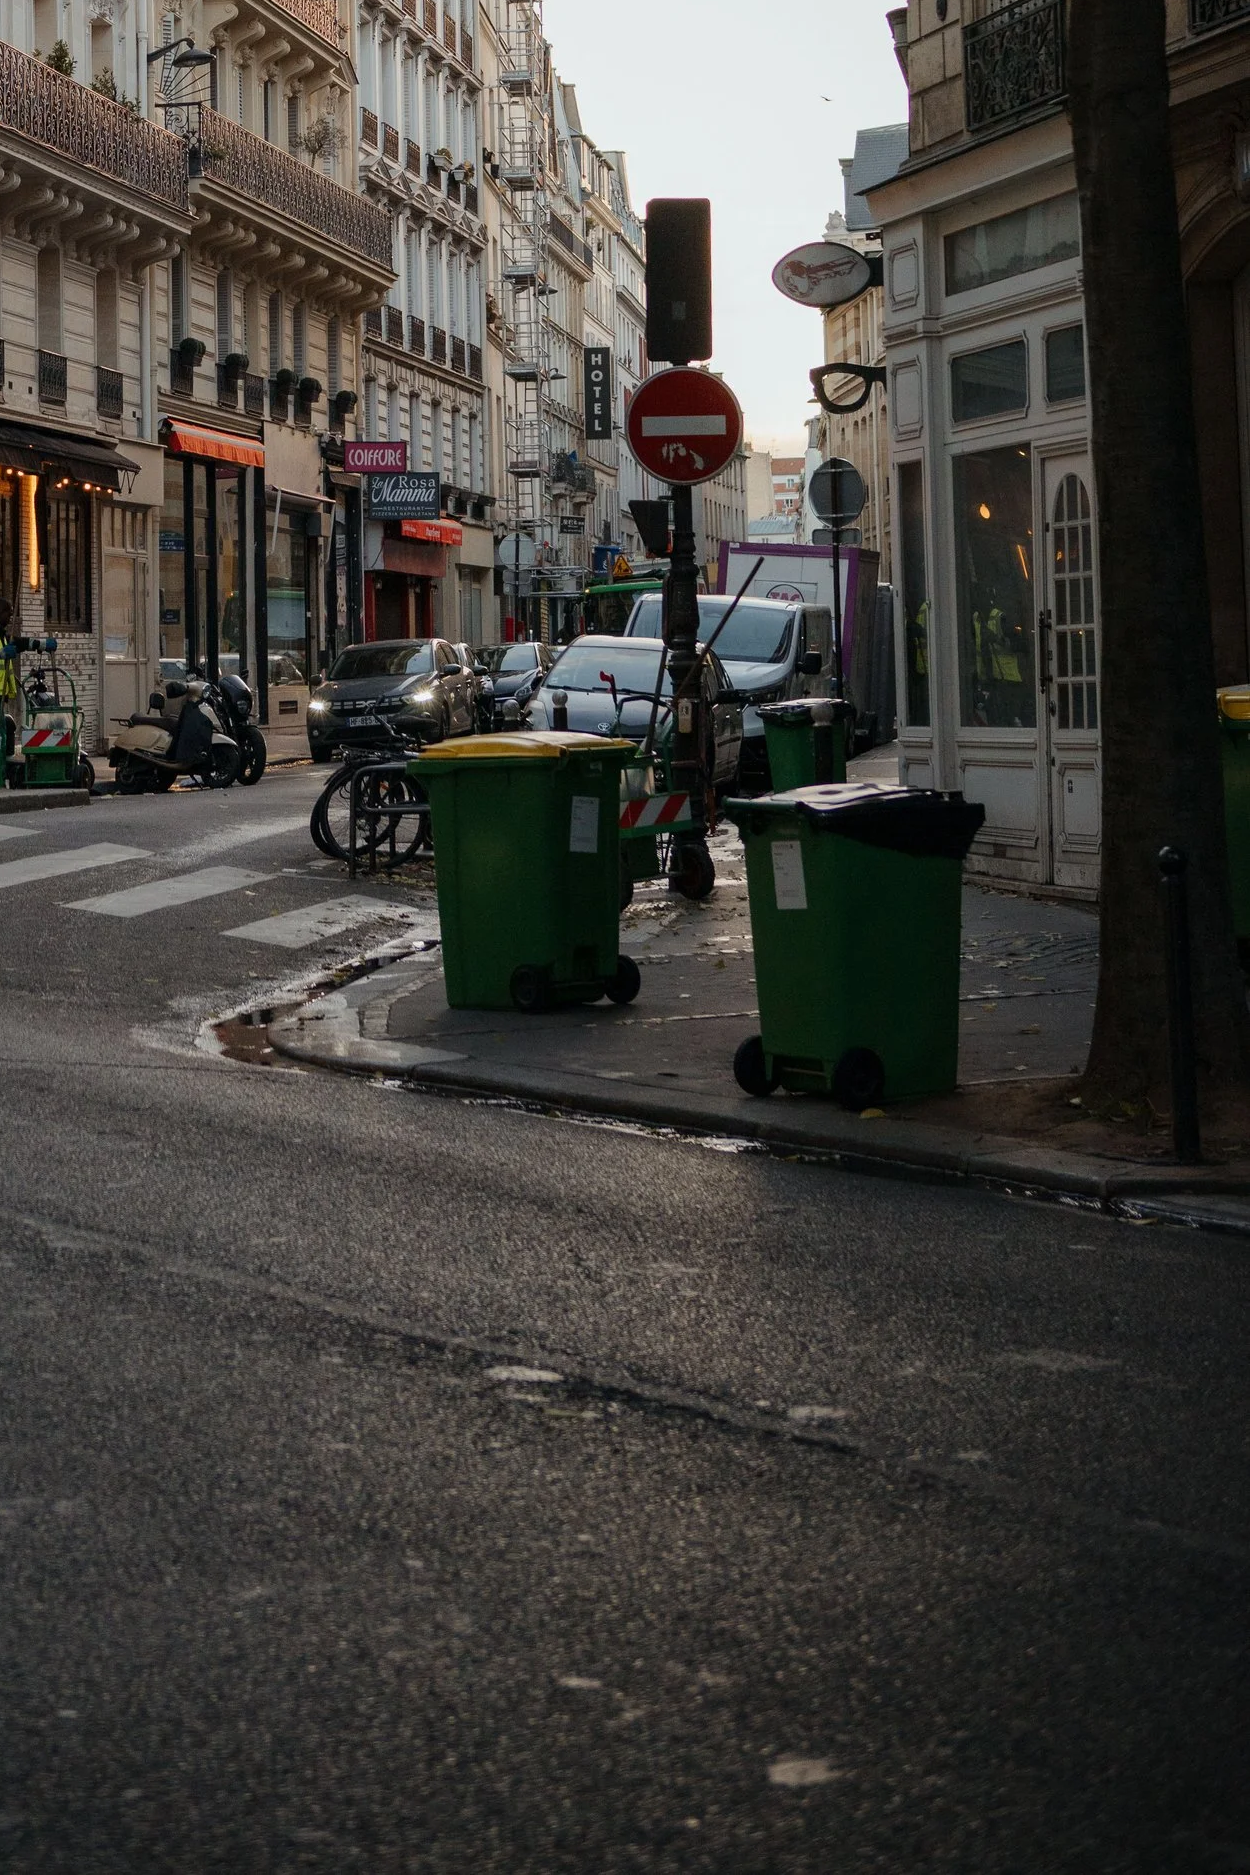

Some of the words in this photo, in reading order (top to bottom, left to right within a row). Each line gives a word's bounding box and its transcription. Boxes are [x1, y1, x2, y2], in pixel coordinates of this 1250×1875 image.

[591, 353, 603, 431] HOTEL
[348, 449, 402, 466] COIFFURE
[372, 476, 436, 503] Mamma
[398, 476, 436, 488] Rosa
